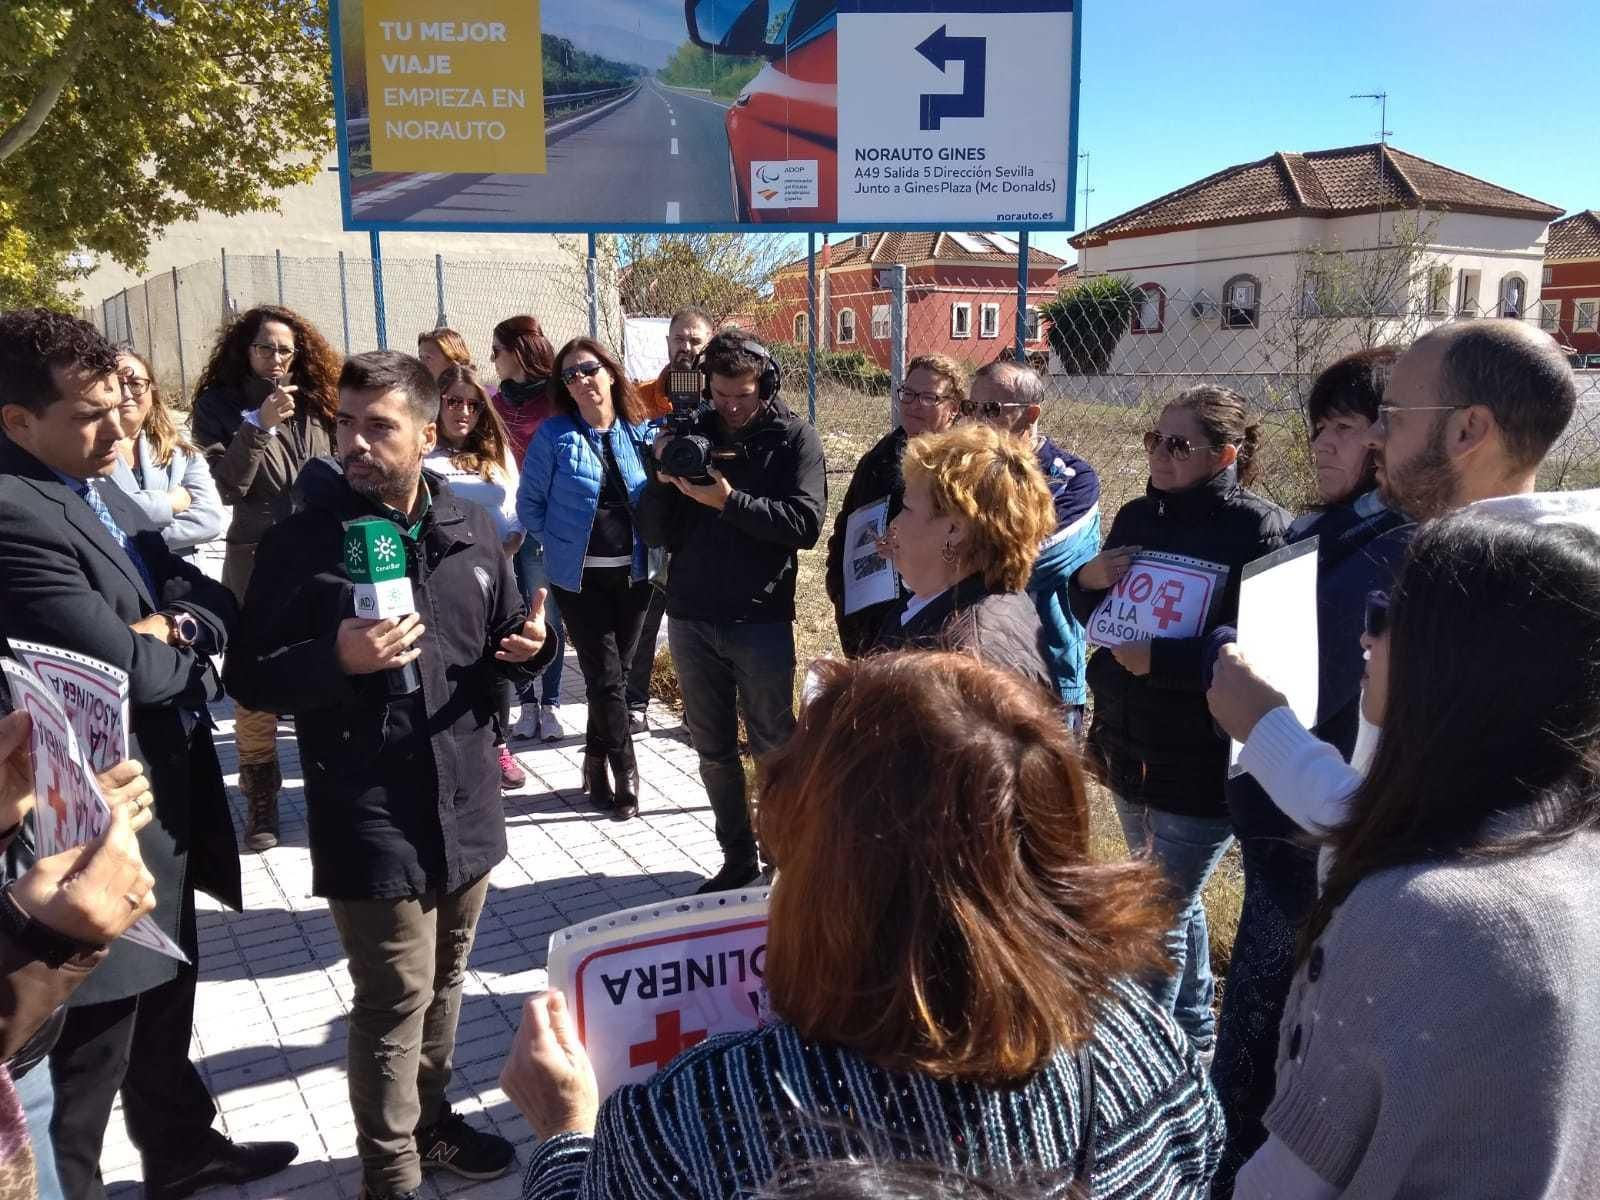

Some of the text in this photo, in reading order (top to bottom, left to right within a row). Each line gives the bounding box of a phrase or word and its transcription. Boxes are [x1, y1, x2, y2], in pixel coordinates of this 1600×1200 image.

[379, 21, 507, 42] TU MEJOR
[381, 54, 452, 75] VIAJE
[384, 87, 526, 109] EMPIEZA EN
[385, 120, 506, 141] NORAUTO
[854, 147, 986, 161] NORAUTO GINES
[854, 165, 1034, 179] A49 Salida 5 Dirección Sevilla
[854, 182, 890, 194] Junto
[894, 184, 901, 194] a
[975, 180, 999, 195] (Mc
[1002, 178, 1056, 193] Donalds)
[996, 211, 1054, 222] norauto.es
[1101, 599, 1138, 625] A LA
[1096, 619, 1155, 641] GASOLIN
[47, 673, 121, 733] ASOLINERA
[600, 942, 768, 1007] OLINERA
